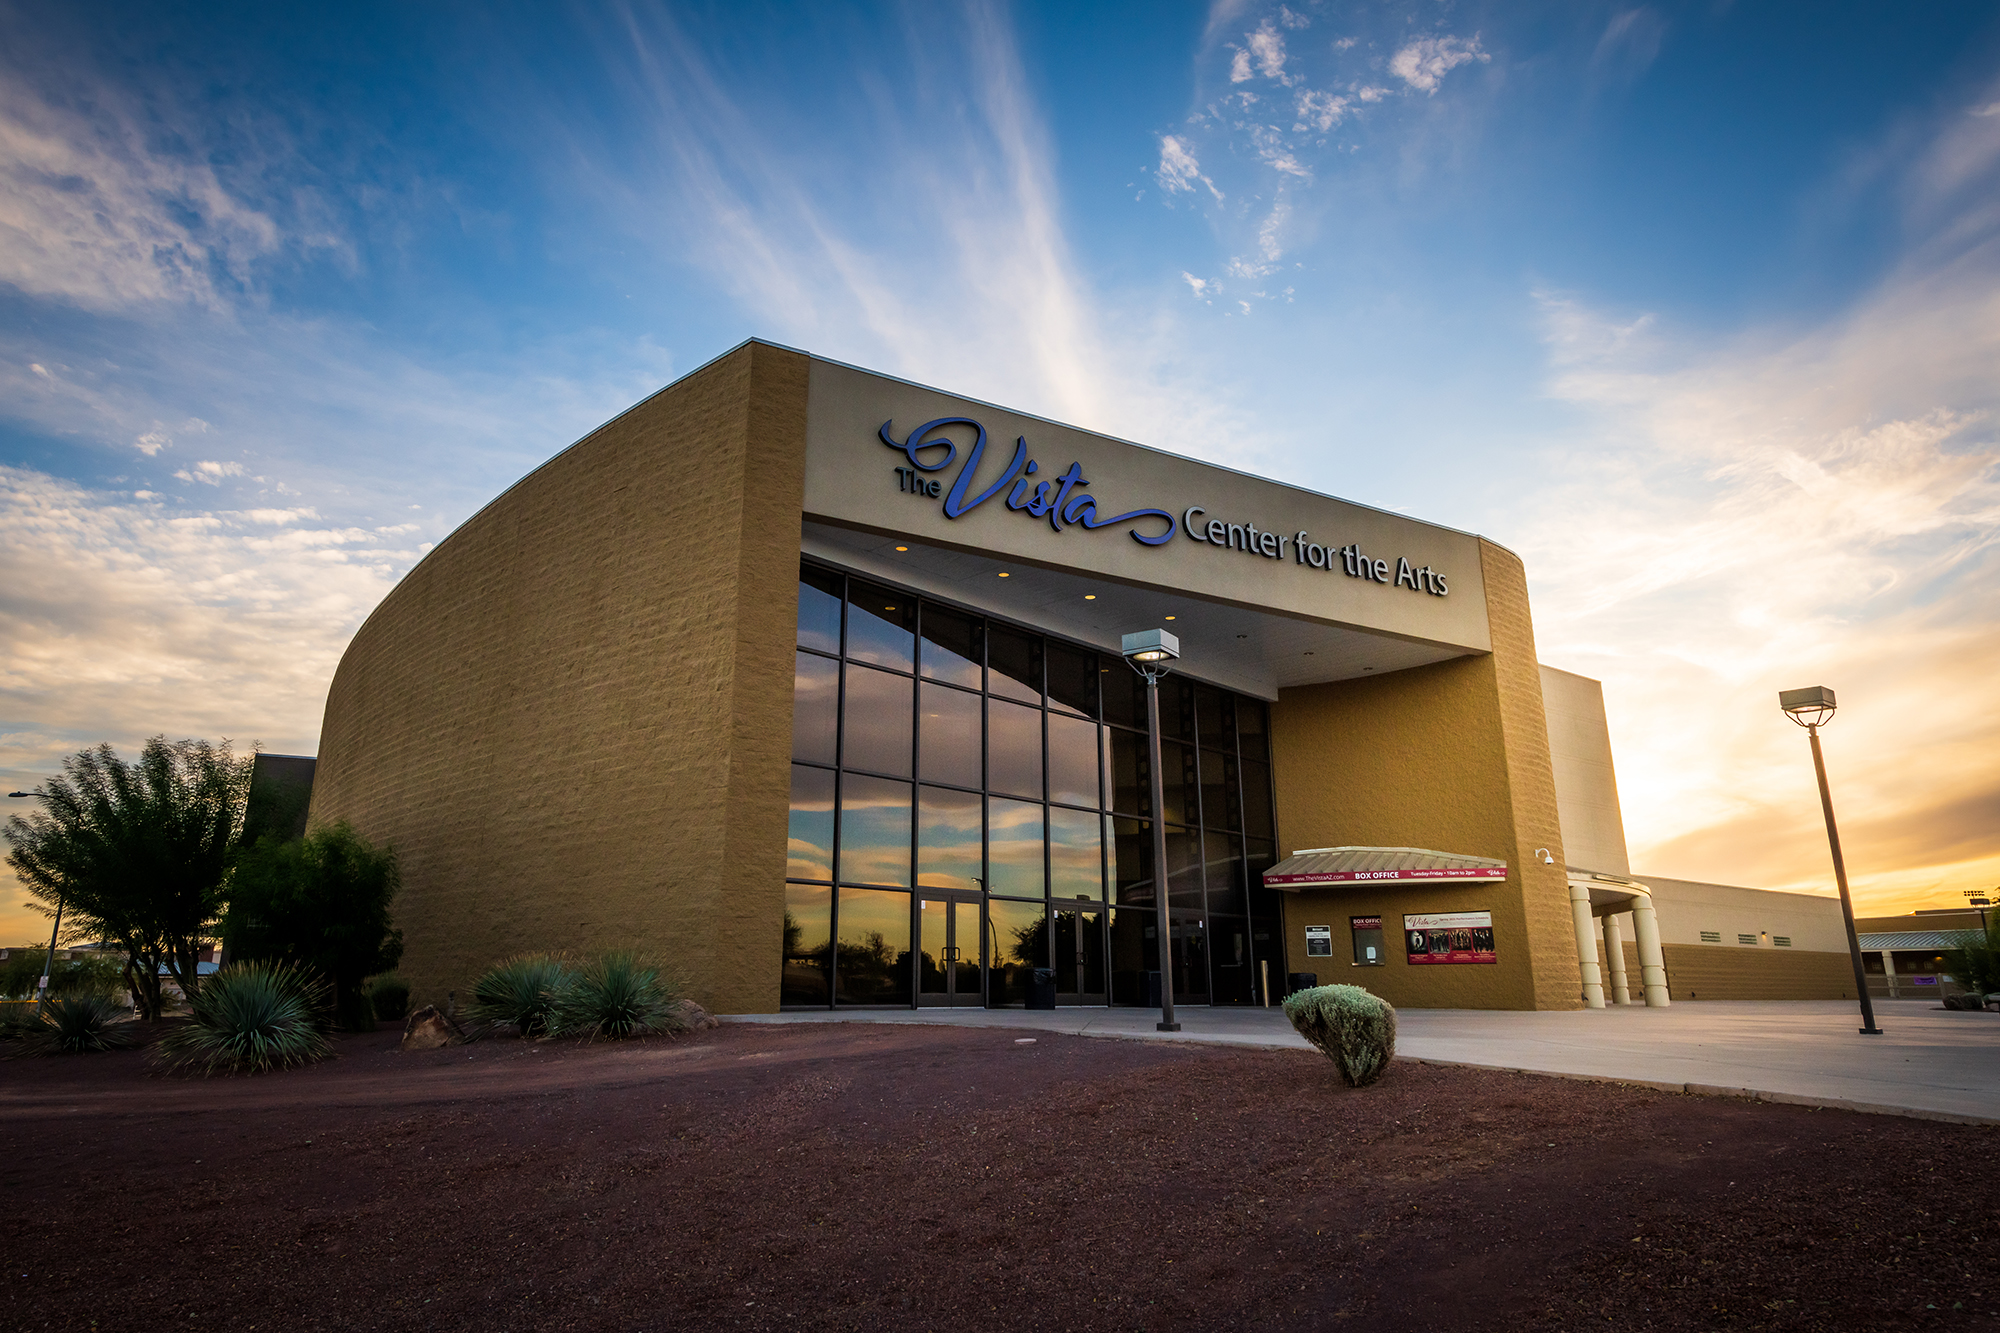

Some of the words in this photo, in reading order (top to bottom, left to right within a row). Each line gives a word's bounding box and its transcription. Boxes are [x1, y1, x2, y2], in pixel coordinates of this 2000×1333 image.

[878, 417, 1176, 547] Vista
[894, 466, 942, 498] The
[1182, 506, 1288, 560] Center
[1292, 530, 1336, 571] for
[1340, 543, 1389, 584] the
[1394, 556, 1449, 597] Arts
[1355, 872, 1372, 880] BOX
[1373, 871, 1399, 879] OFFICE
